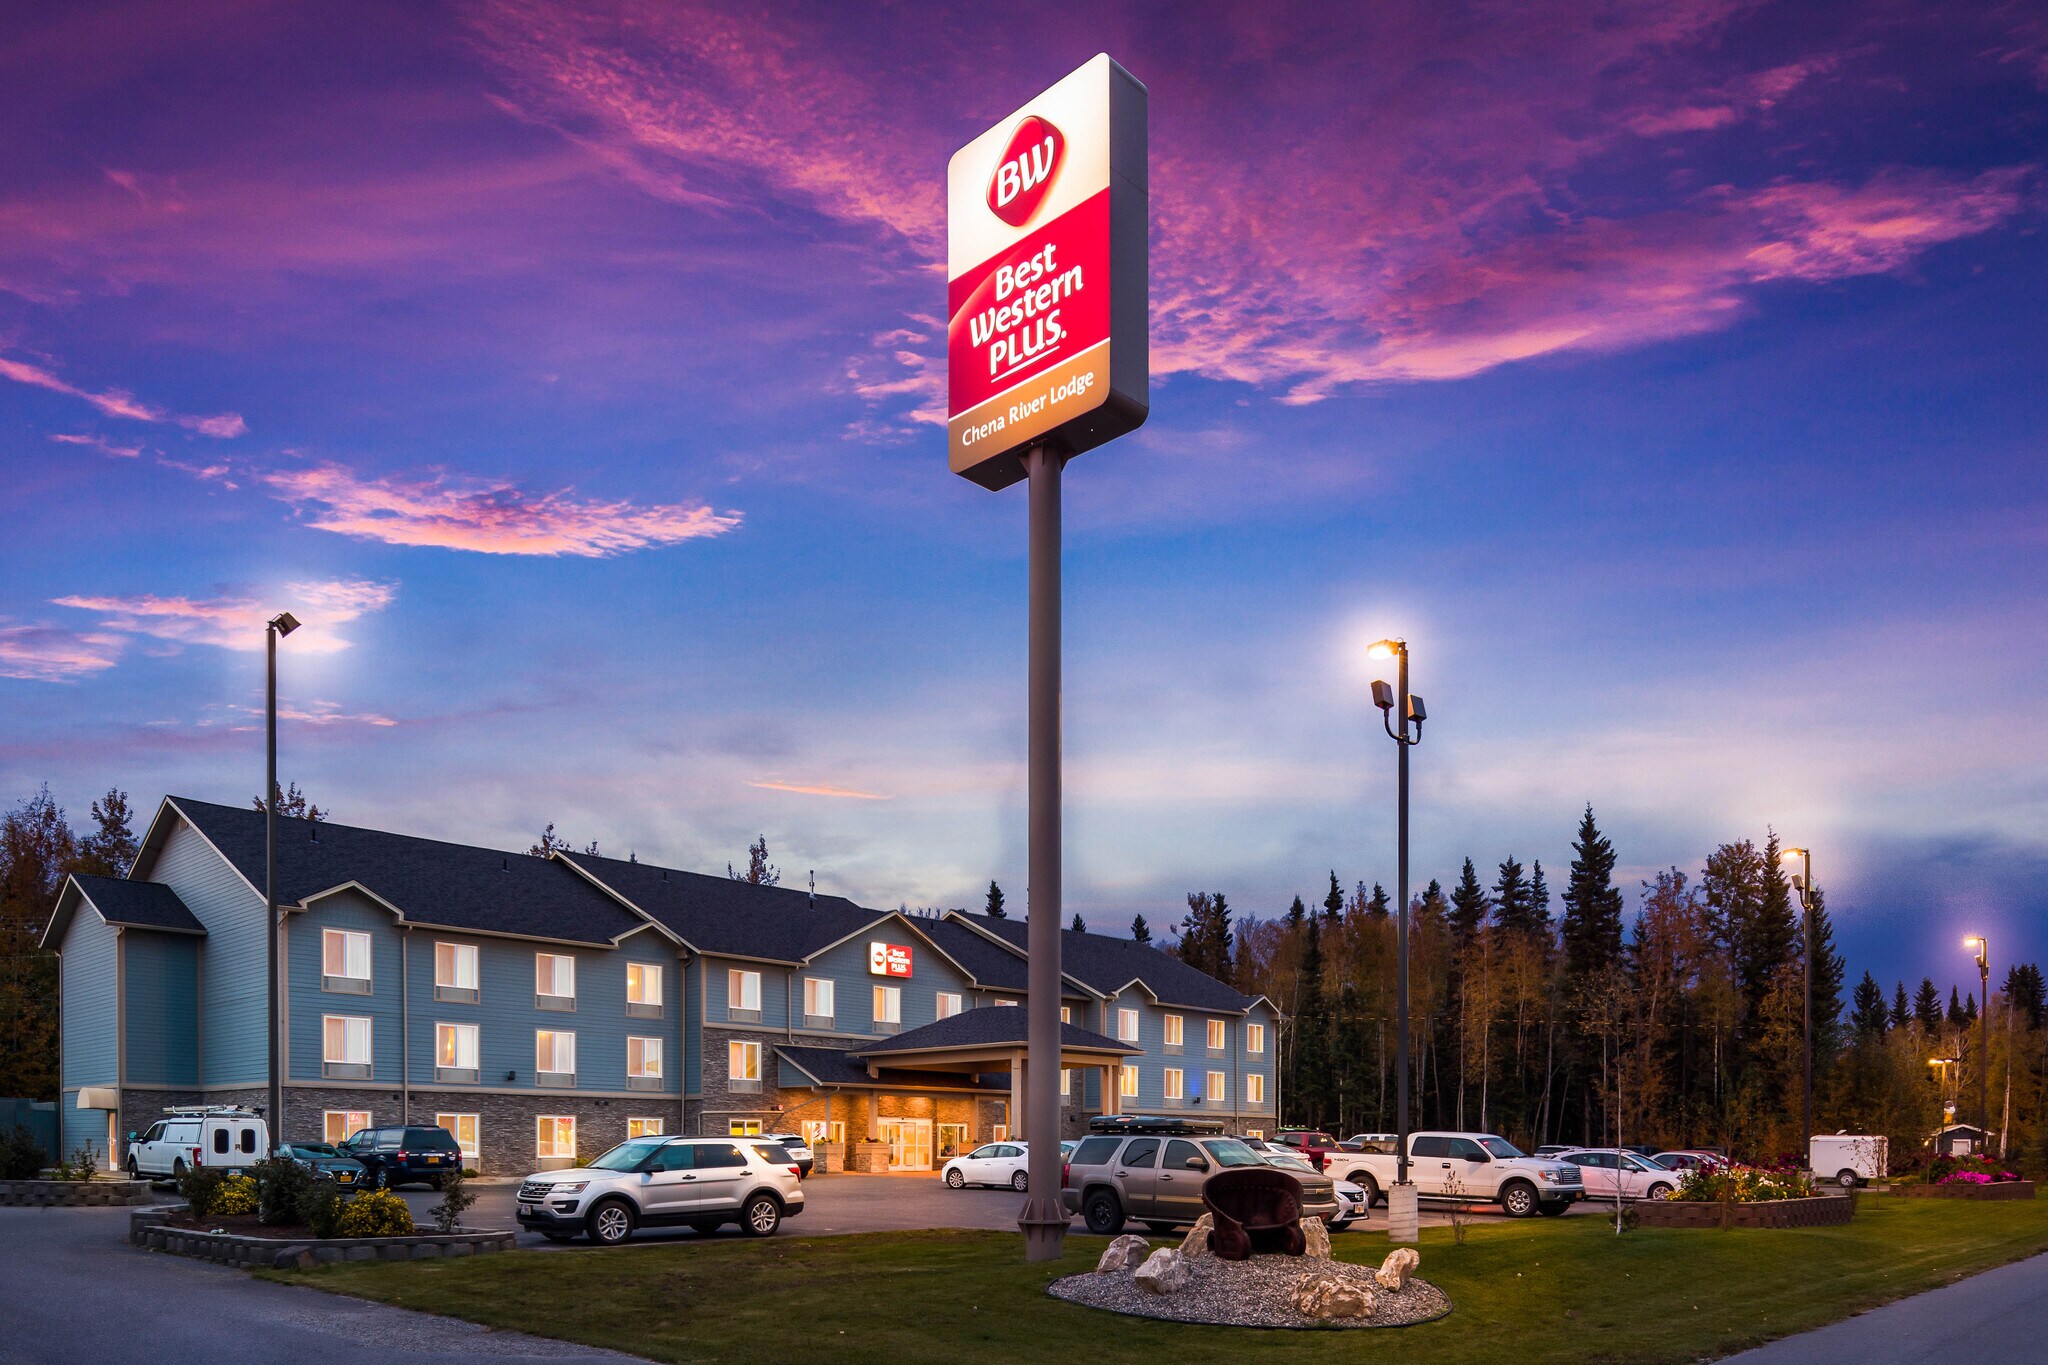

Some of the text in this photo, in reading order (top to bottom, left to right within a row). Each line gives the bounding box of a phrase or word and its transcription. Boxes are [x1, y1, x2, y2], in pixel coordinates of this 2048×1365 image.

[997, 135, 1055, 208] BW
[969, 265, 1084, 348] Western
[995, 243, 1057, 302] Best
[962, 371, 1094, 446] Chena River Lodge
